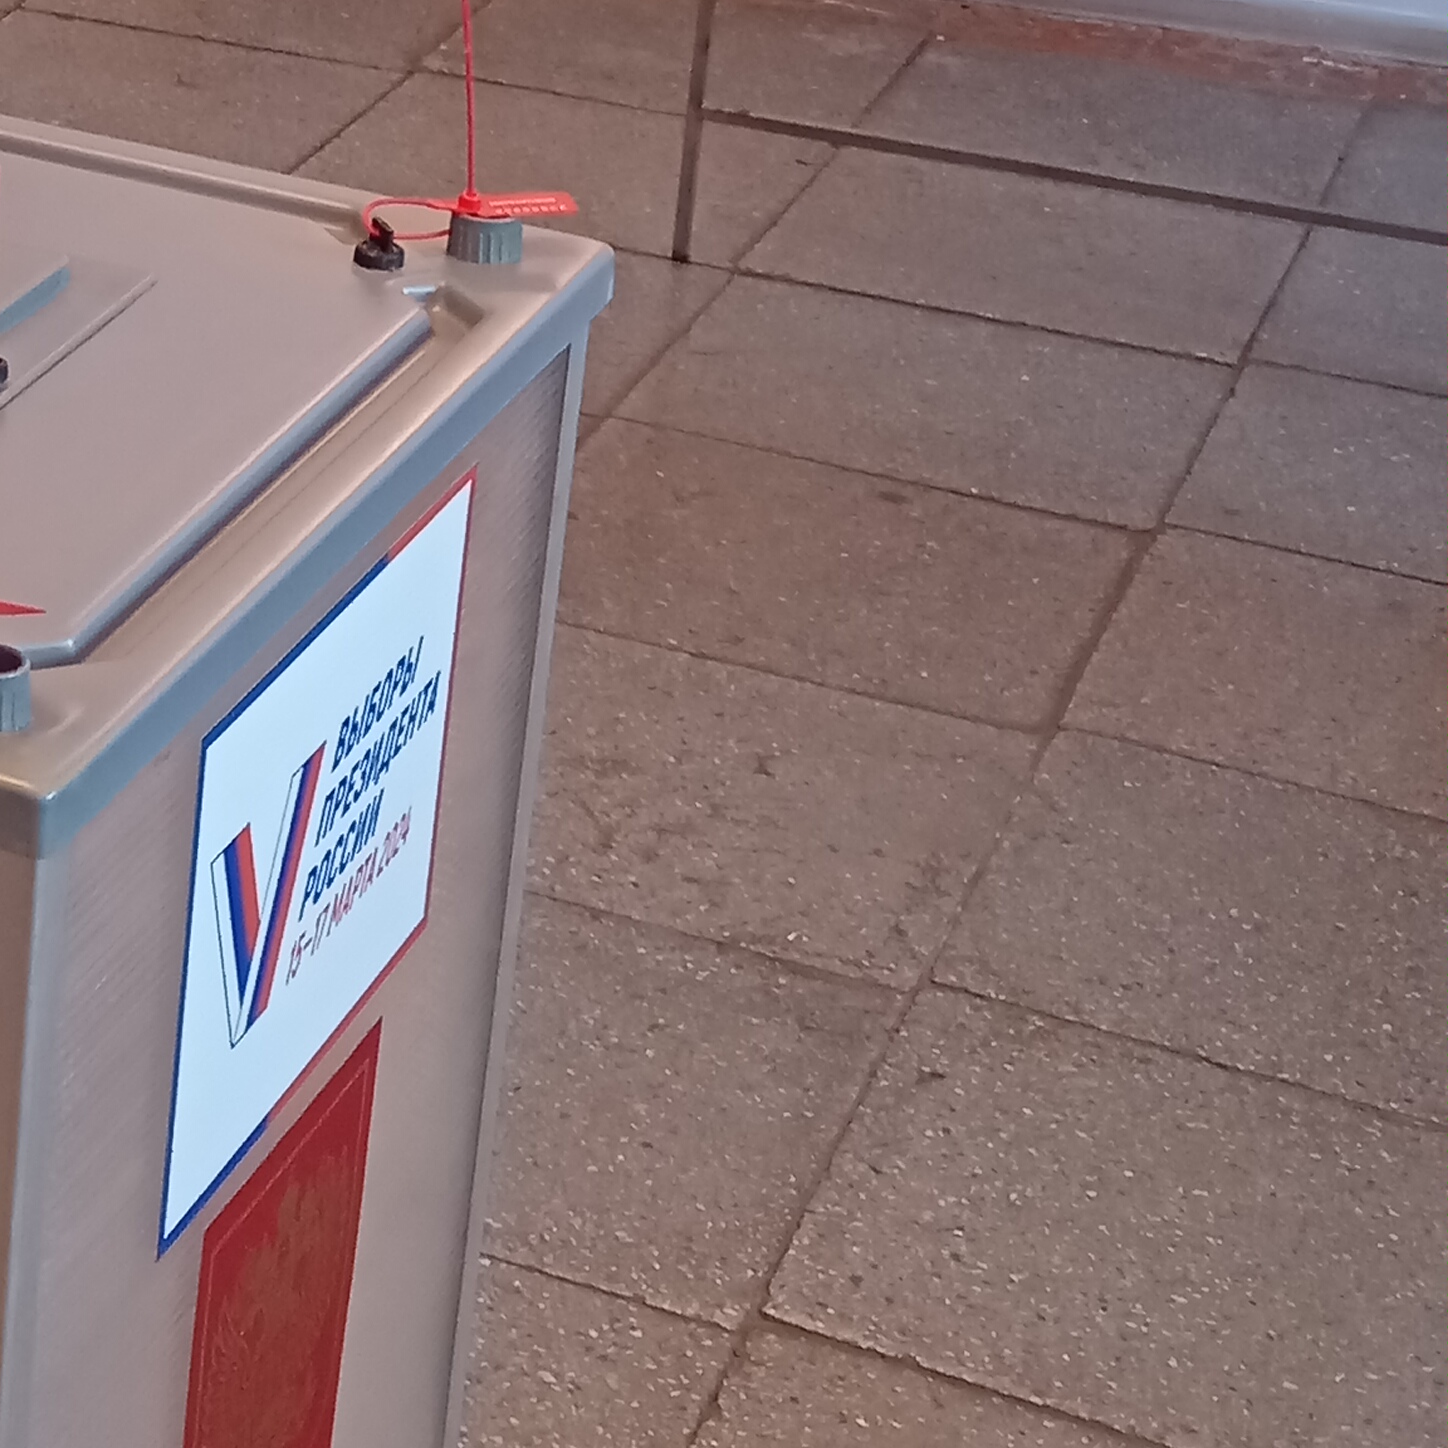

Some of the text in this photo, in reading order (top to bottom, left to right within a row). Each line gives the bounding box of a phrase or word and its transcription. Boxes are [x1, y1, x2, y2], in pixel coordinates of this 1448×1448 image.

[314, 670, 442, 847] ПРЕЗИДЕНТА
[331, 635, 424, 773] ВЫБОРЫ
[298, 786, 385, 922] РОССИИ
[326, 846, 380, 937] МАРТА
[376, 805, 412, 878] 2024
